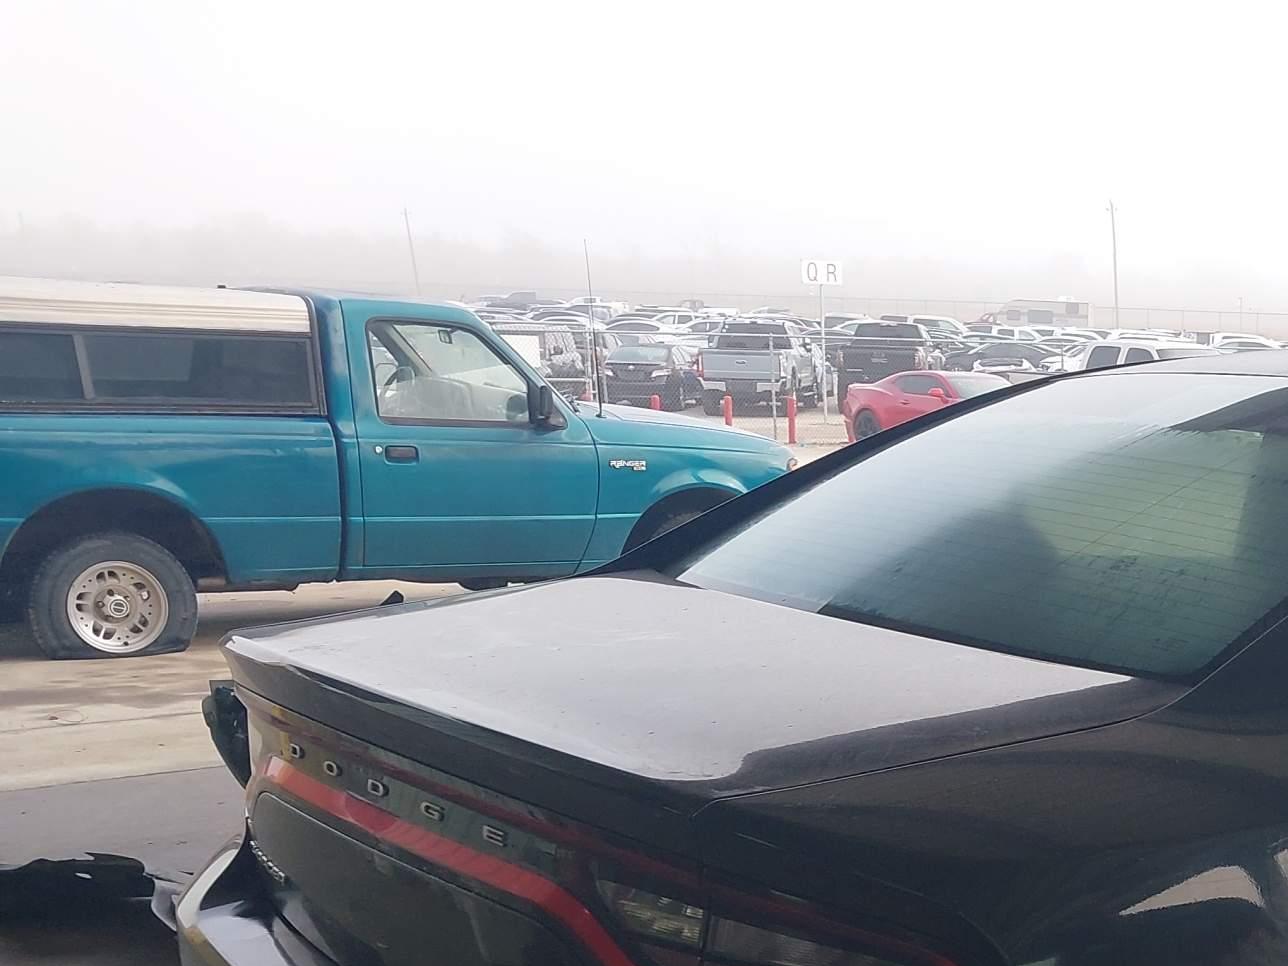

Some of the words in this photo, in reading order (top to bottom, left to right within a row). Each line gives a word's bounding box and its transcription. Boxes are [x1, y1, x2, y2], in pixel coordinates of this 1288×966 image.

[806, 262, 818, 282] Q
[826, 263, 838, 282] R
[609, 459, 646, 468] RANGER
[289, 742, 508, 848] DODGE
